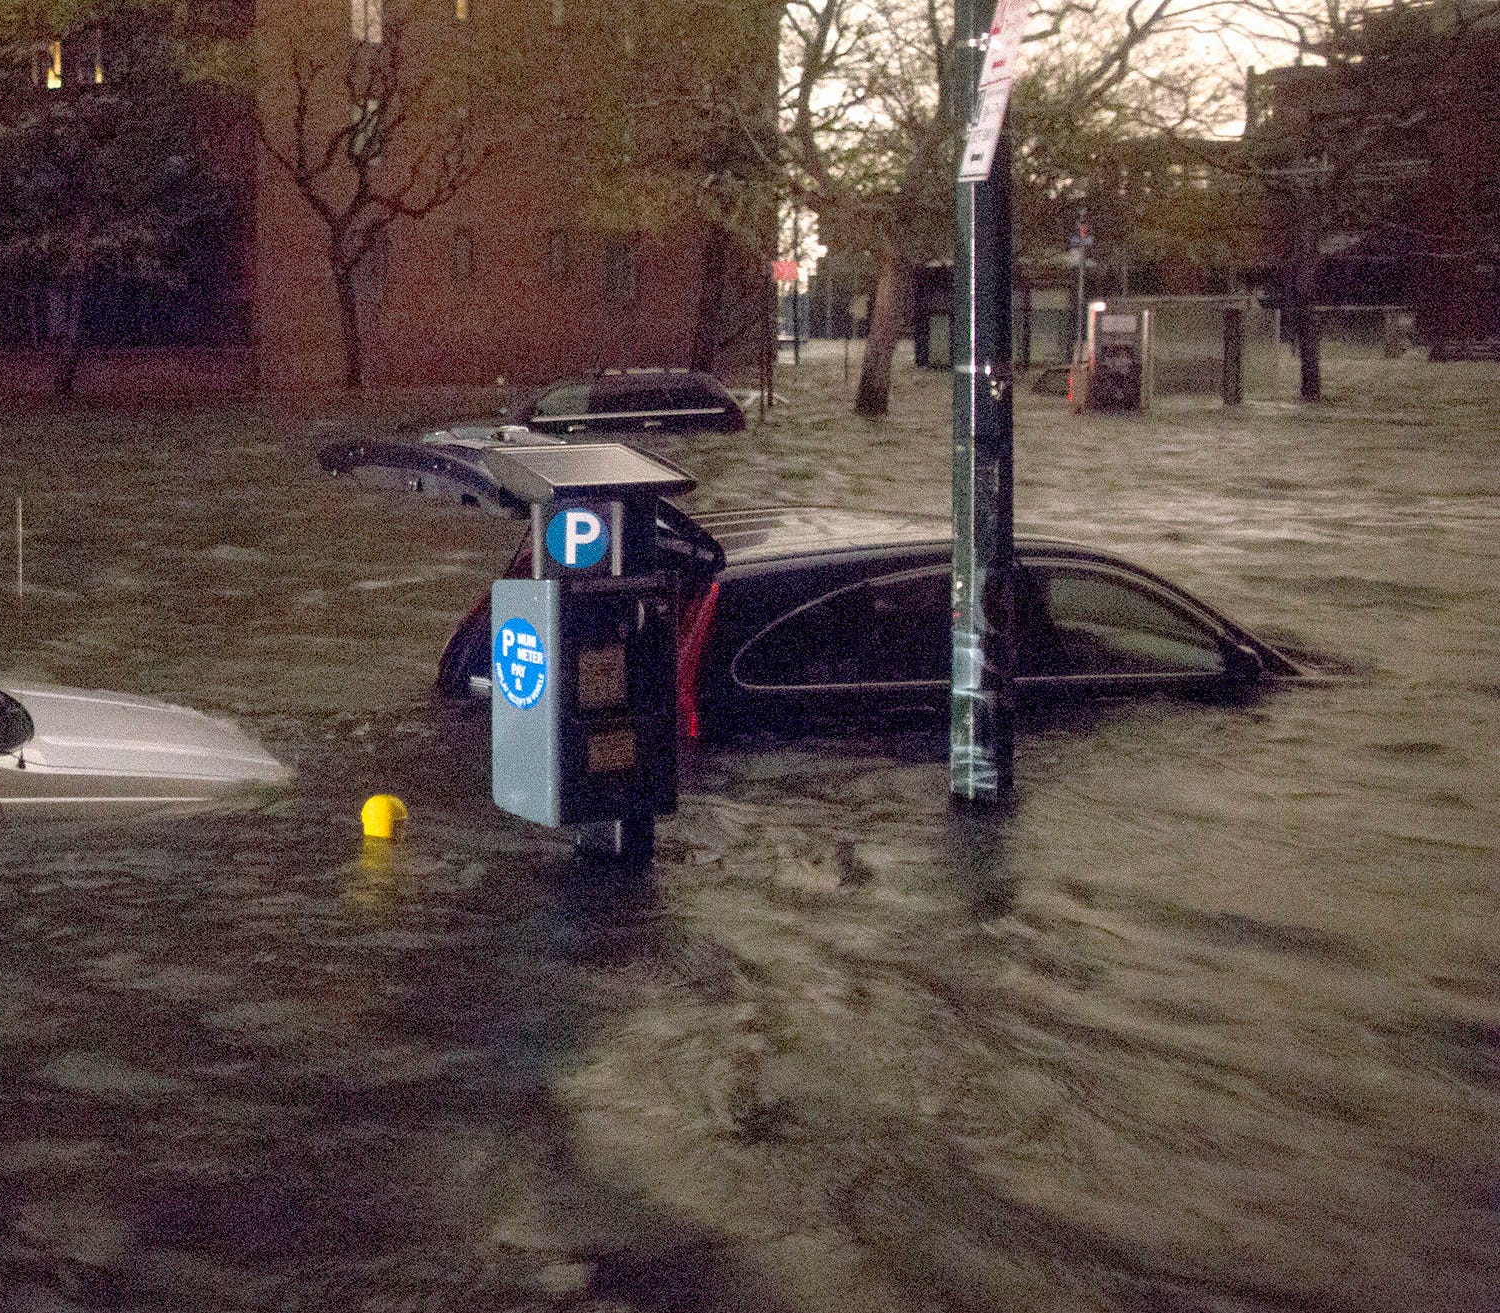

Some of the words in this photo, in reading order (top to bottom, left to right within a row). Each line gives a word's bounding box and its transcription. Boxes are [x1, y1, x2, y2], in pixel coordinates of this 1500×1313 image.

[565, 511, 601, 565] P
[502, 629, 515, 657] P
[511, 662, 526, 678] PAY
